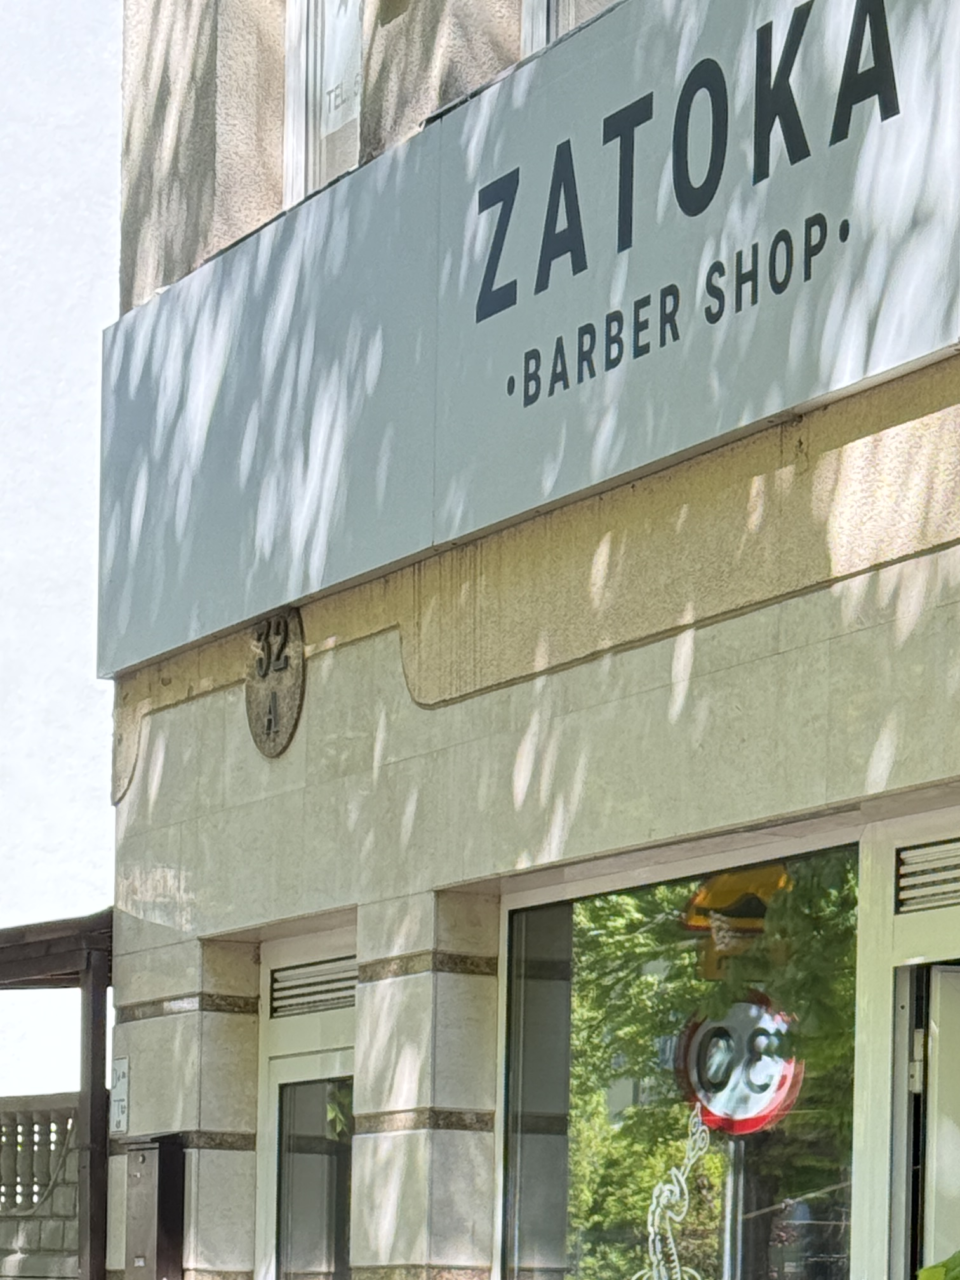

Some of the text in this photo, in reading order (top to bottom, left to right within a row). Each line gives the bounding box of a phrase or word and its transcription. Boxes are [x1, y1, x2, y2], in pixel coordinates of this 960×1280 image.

[475, 0, 900, 324] ZATOKA
[523, 212, 828, 408] BARBER SHOP
